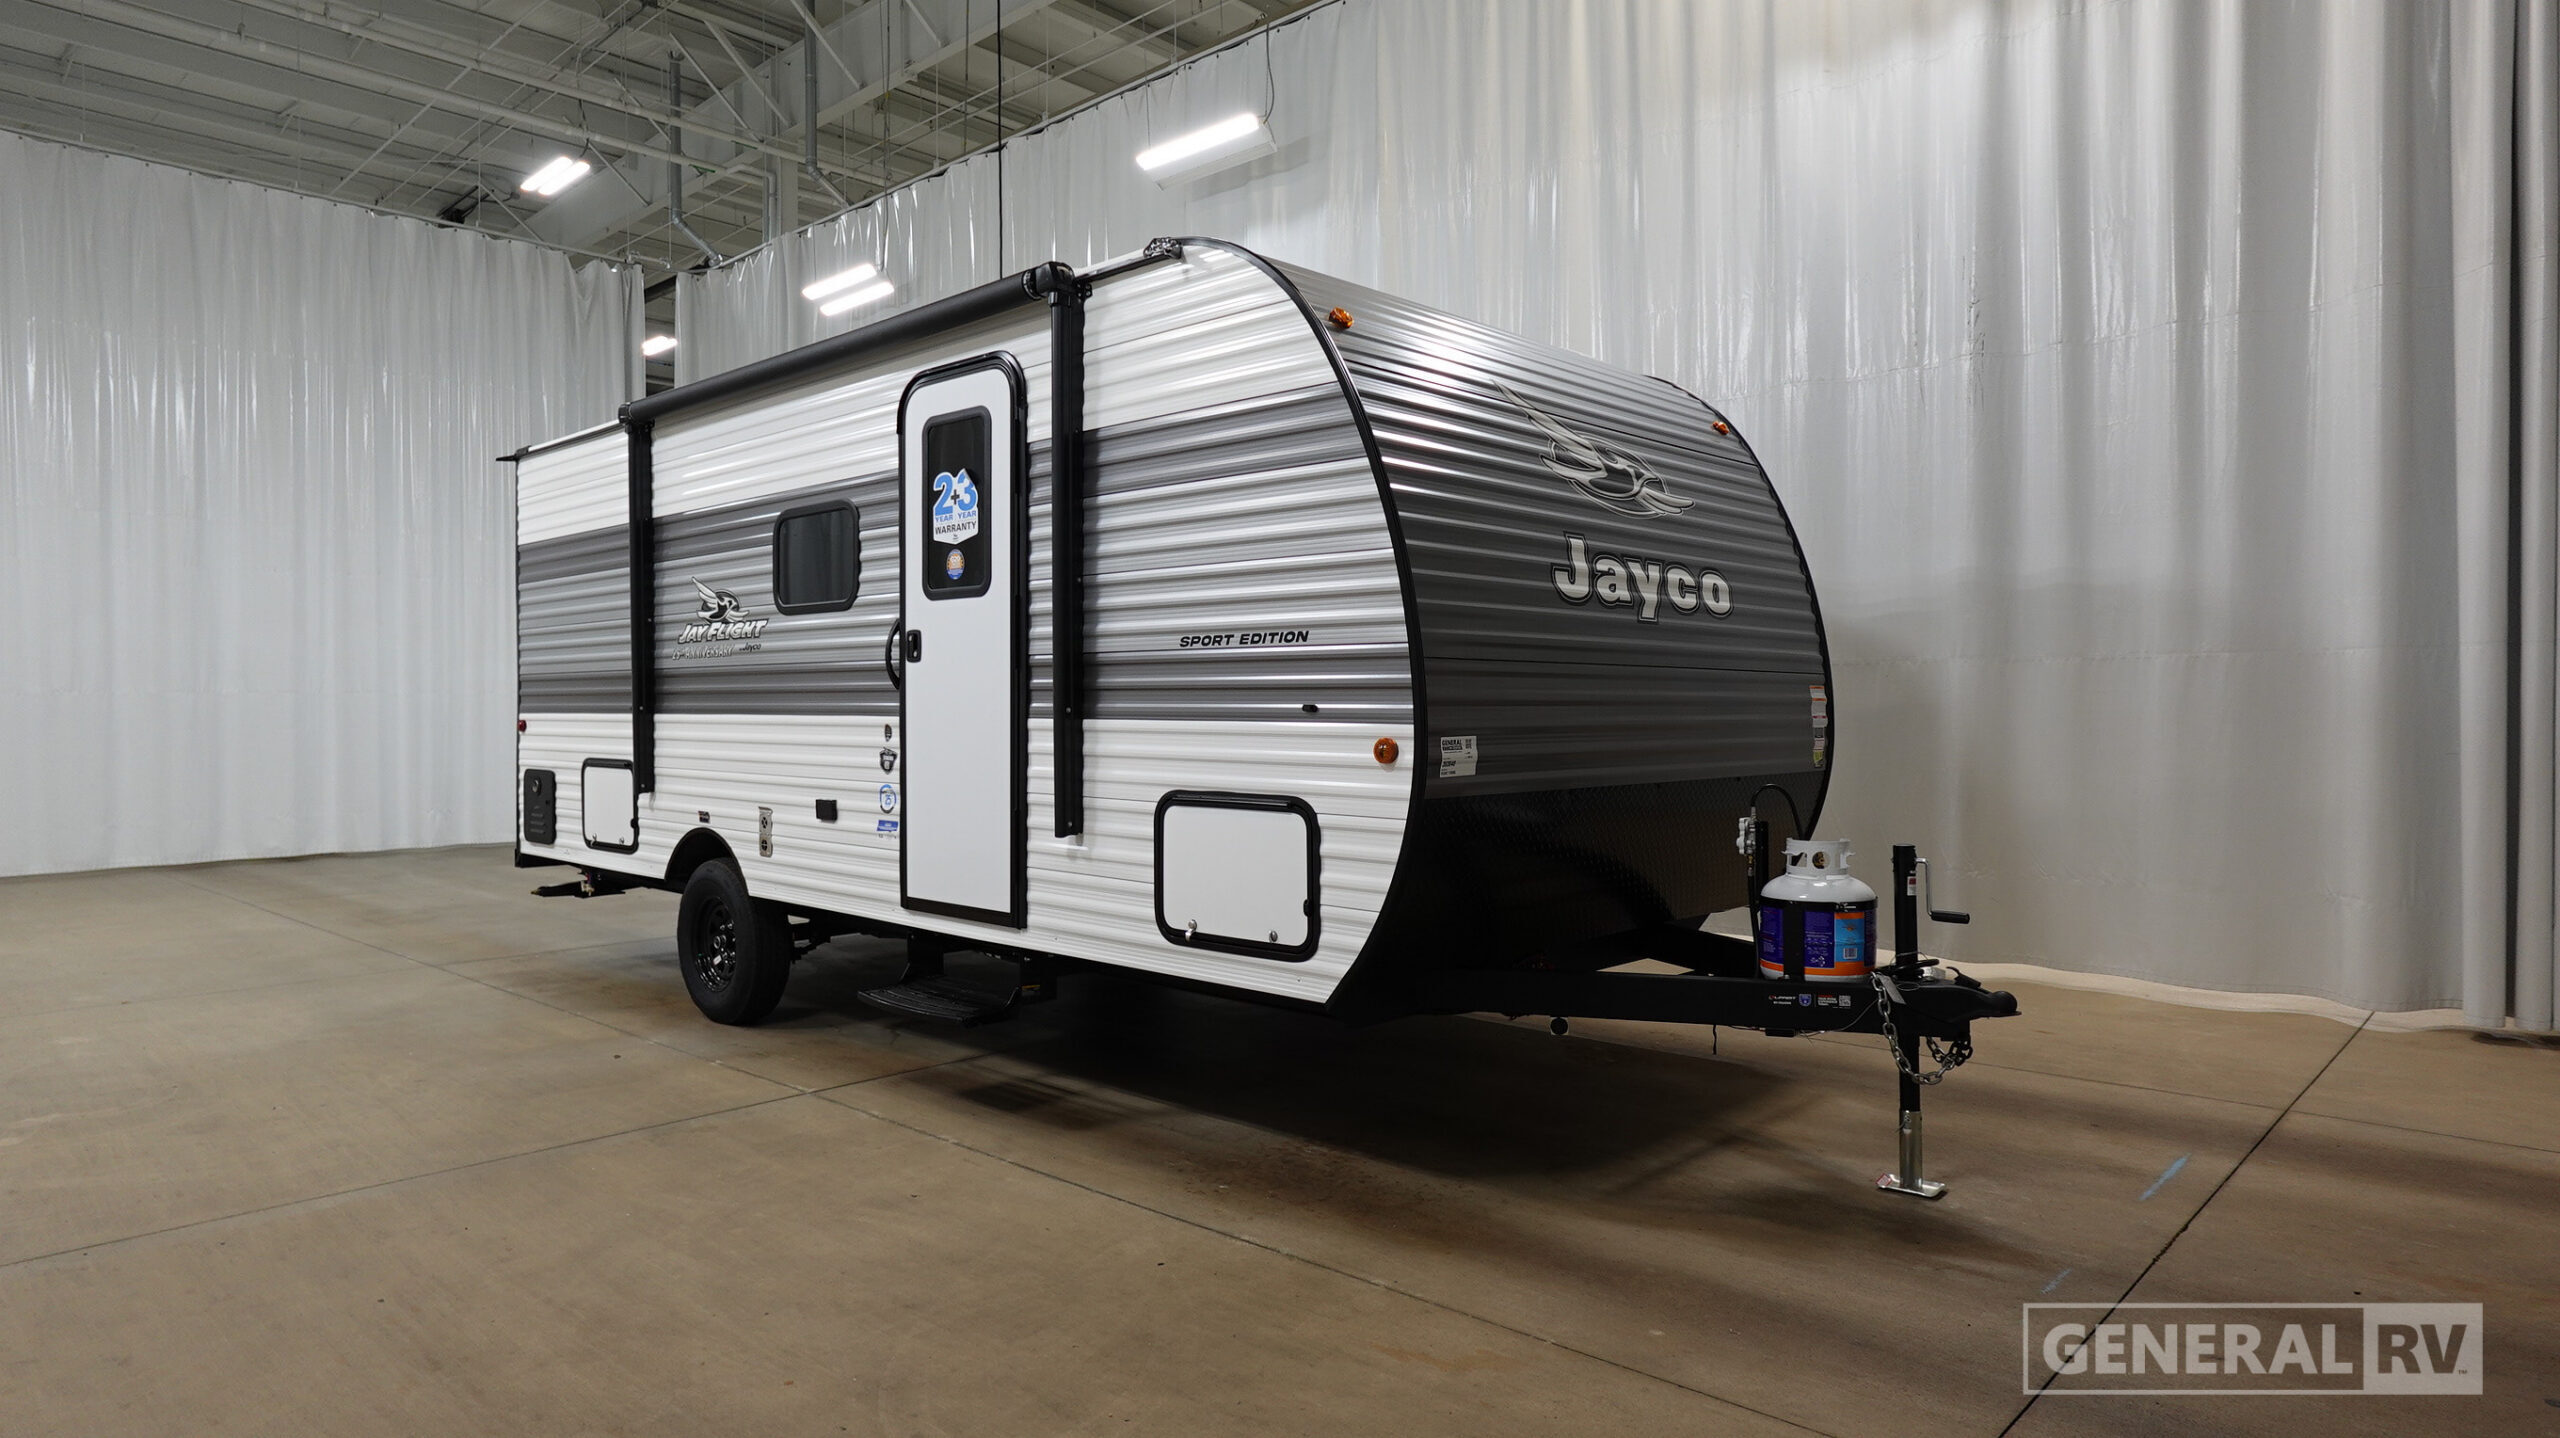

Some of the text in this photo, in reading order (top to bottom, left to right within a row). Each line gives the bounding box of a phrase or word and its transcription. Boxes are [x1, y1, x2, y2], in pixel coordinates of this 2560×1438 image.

[935, 510, 977, 523] YEAR YEAR
[935, 520, 977, 536] WARRANTY
[1552, 533, 1733, 622] Jayco
[678, 618, 769, 645] JAY FLIGHT
[1179, 630, 1310, 648] SPORT EDITION
